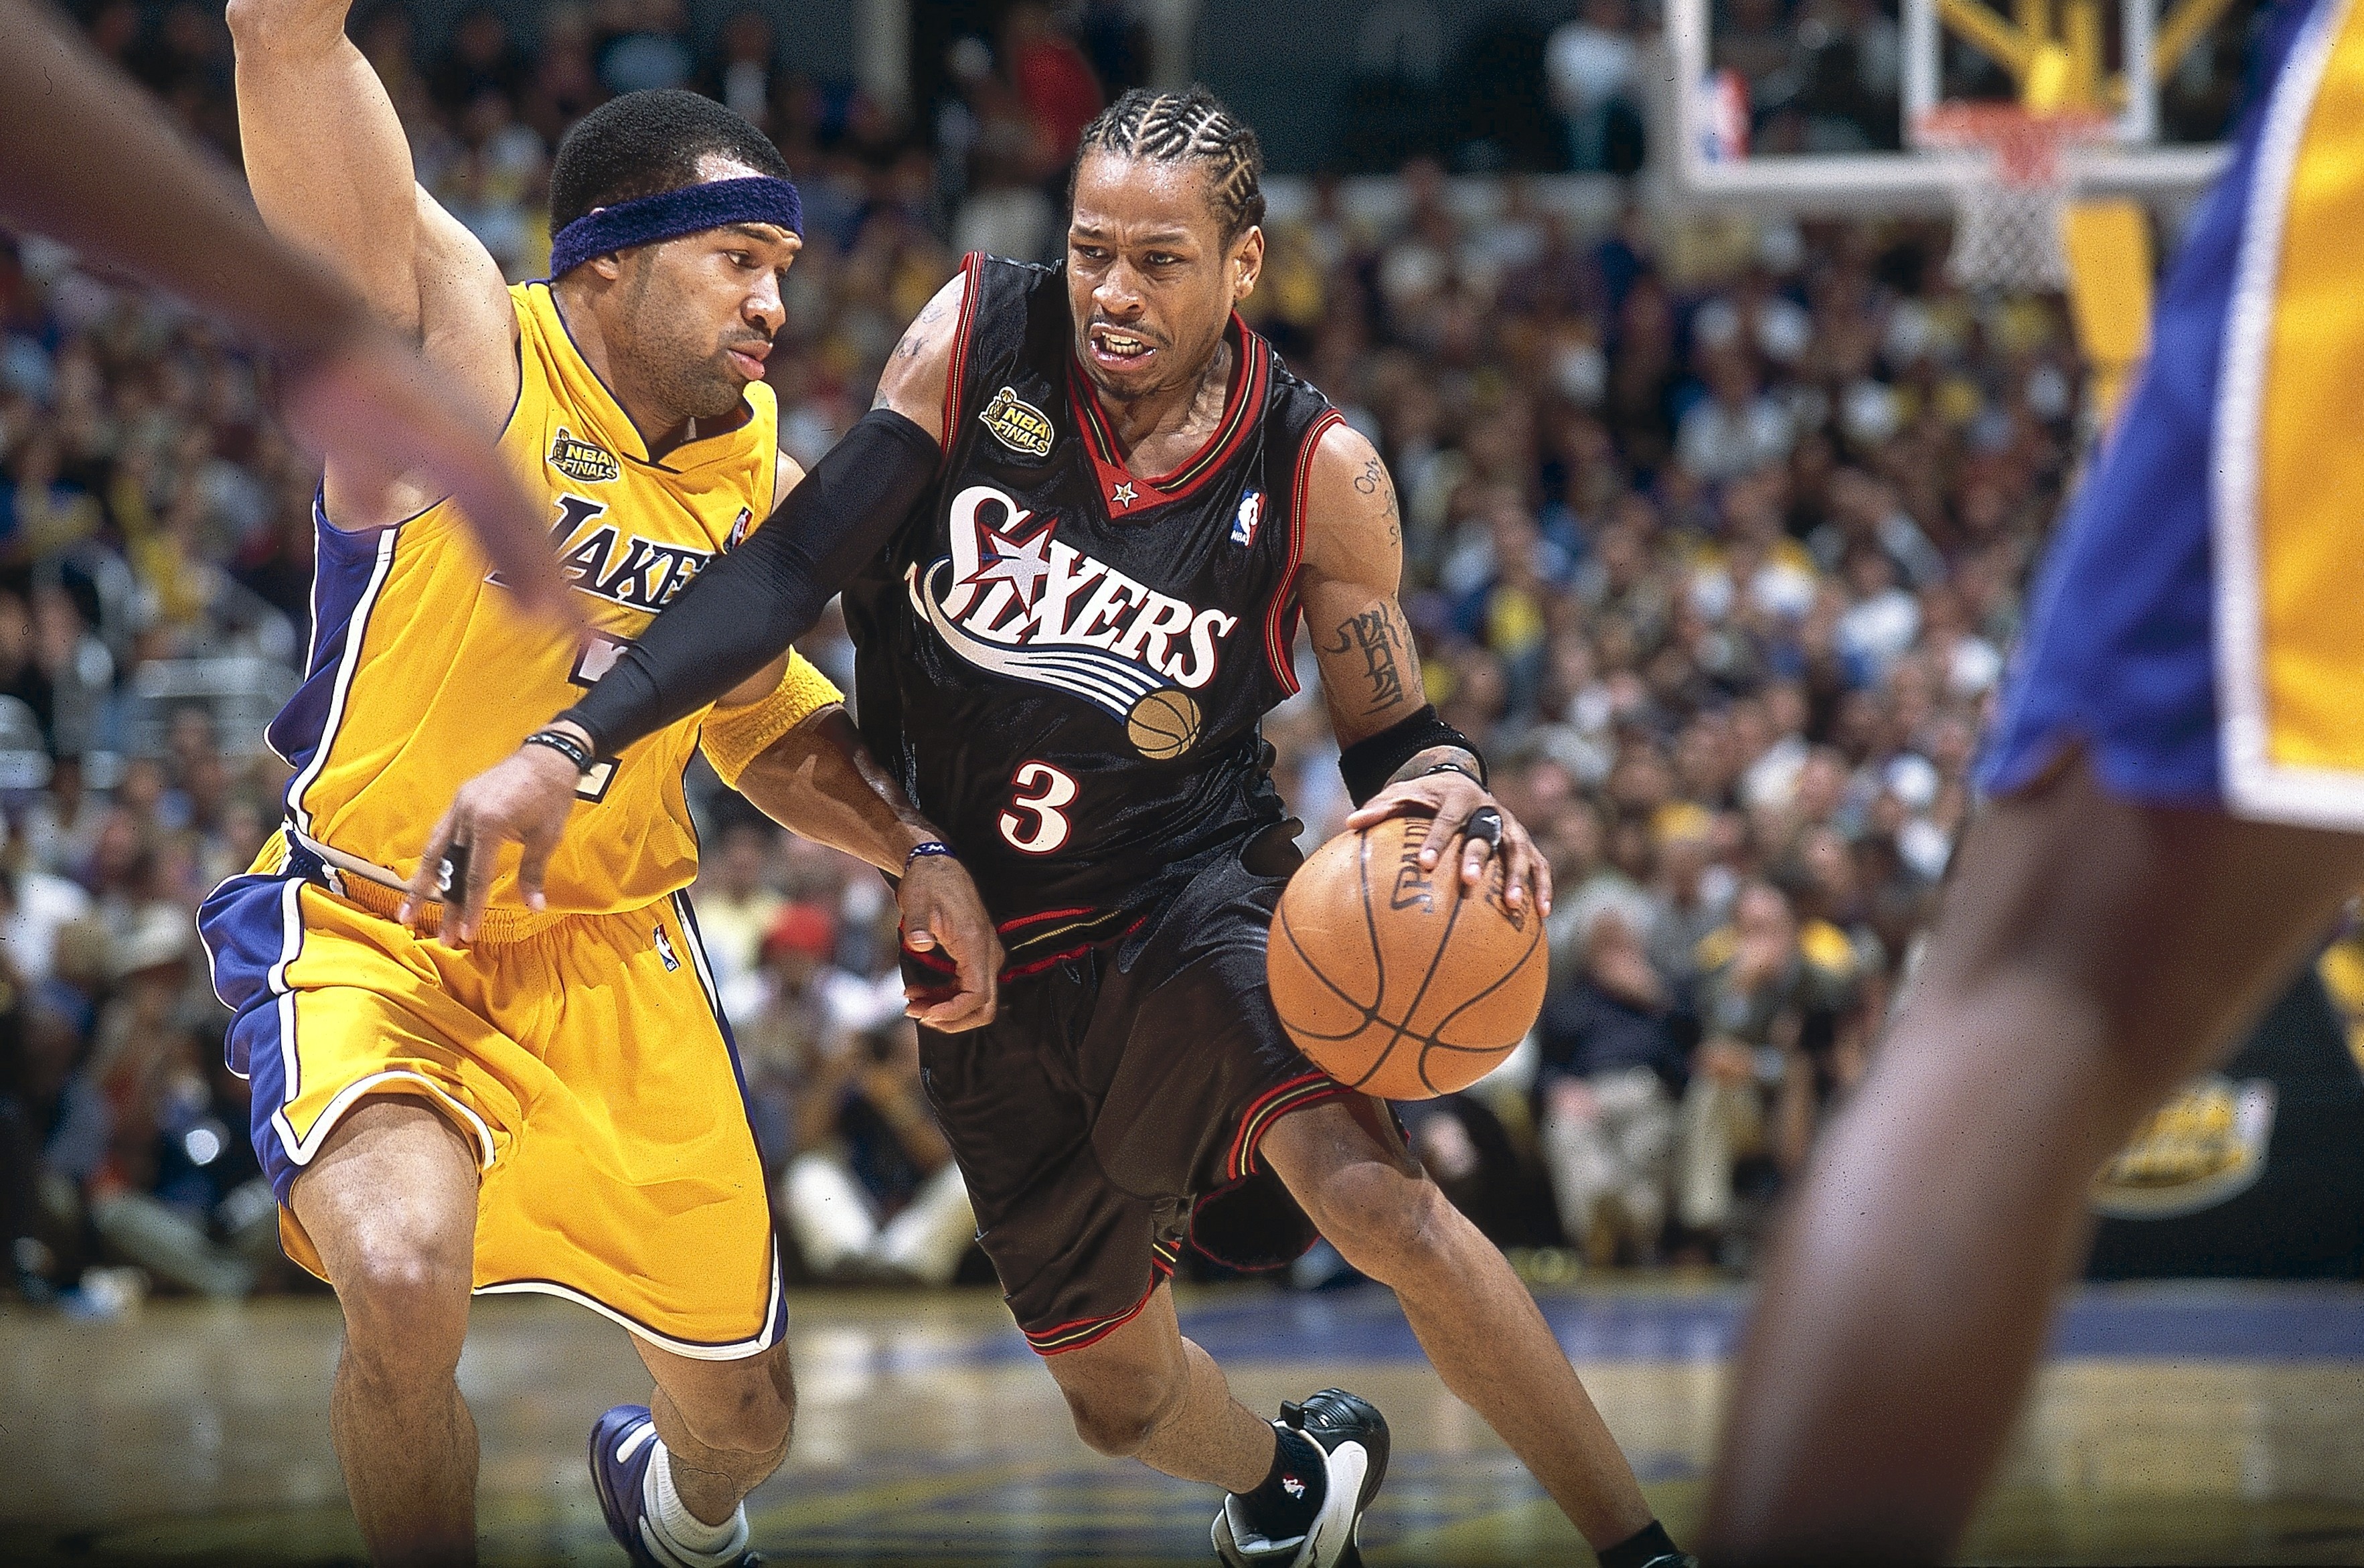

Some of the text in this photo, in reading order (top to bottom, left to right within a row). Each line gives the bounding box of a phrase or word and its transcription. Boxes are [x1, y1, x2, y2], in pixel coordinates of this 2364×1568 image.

[994, 418, 1049, 453] FINALS
[1002, 406, 1049, 439] NBA
[562, 458, 617, 479] FINALS
[565, 443, 611, 466] NBA
[484, 491, 716, 614] LAKE
[1230, 529, 1247, 544] NBA
[940, 485, 1239, 690] SIXERS
[997, 759, 1081, 855] 3
